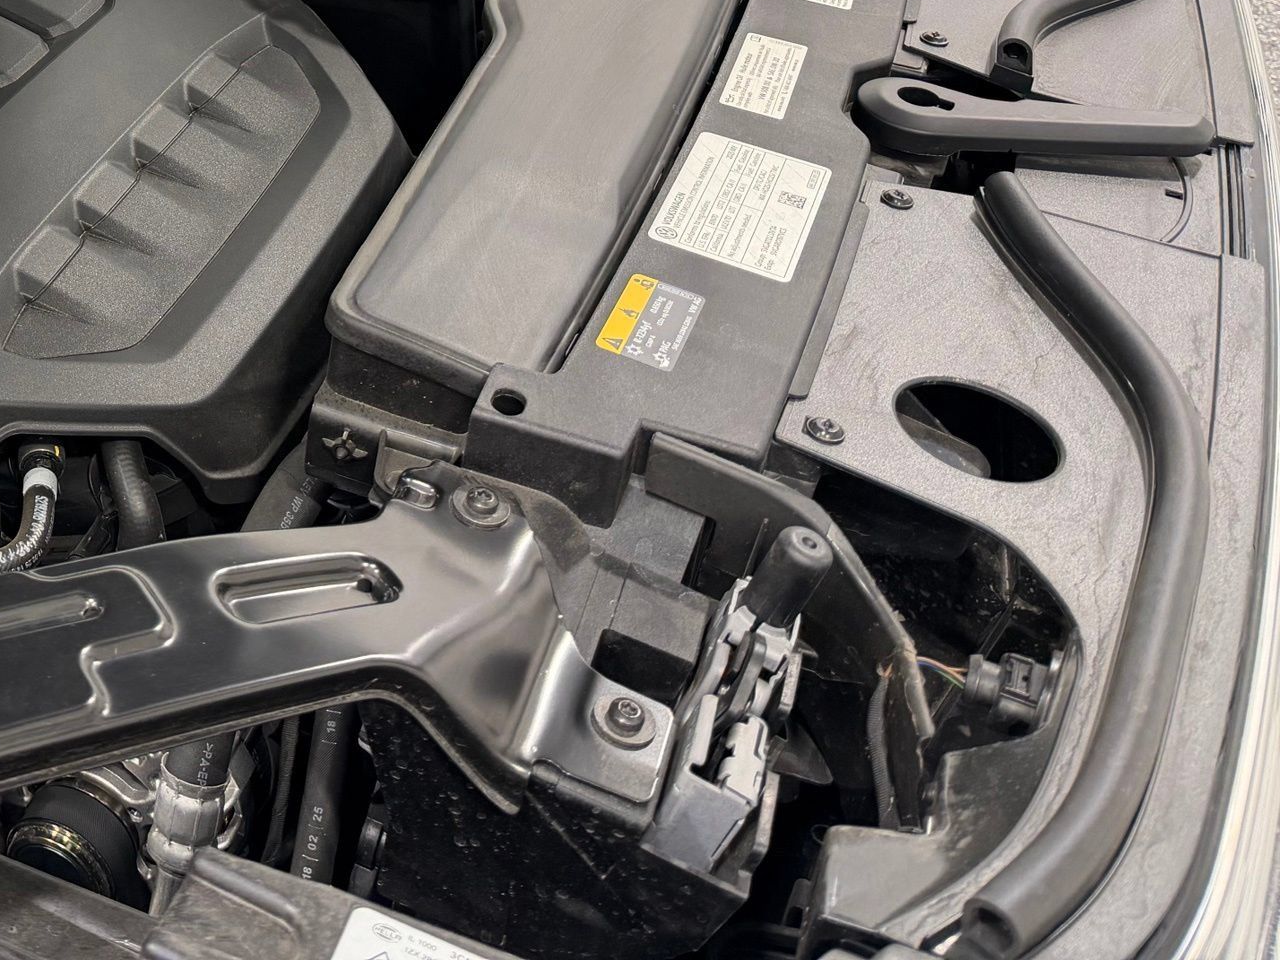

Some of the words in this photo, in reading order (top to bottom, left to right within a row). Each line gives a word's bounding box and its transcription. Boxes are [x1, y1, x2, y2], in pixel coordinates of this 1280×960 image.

[673, 212, 686, 228] VEHICLE
[681, 195, 694, 212] EMISSION
[690, 179, 702, 196] CONTROL
[698, 156, 714, 179] INFORMATION
[663, 191, 685, 225] VOLKSWAGEN
[684, 224, 699, 243] Conforms
[633, 320, 654, 344] R-1234yf
[659, 340, 671, 353] PAG
[326, 720, 336, 733] 18
[312, 806, 324, 822] 25
[307, 834, 319, 851] 02
[301, 866, 313, 880] 18
